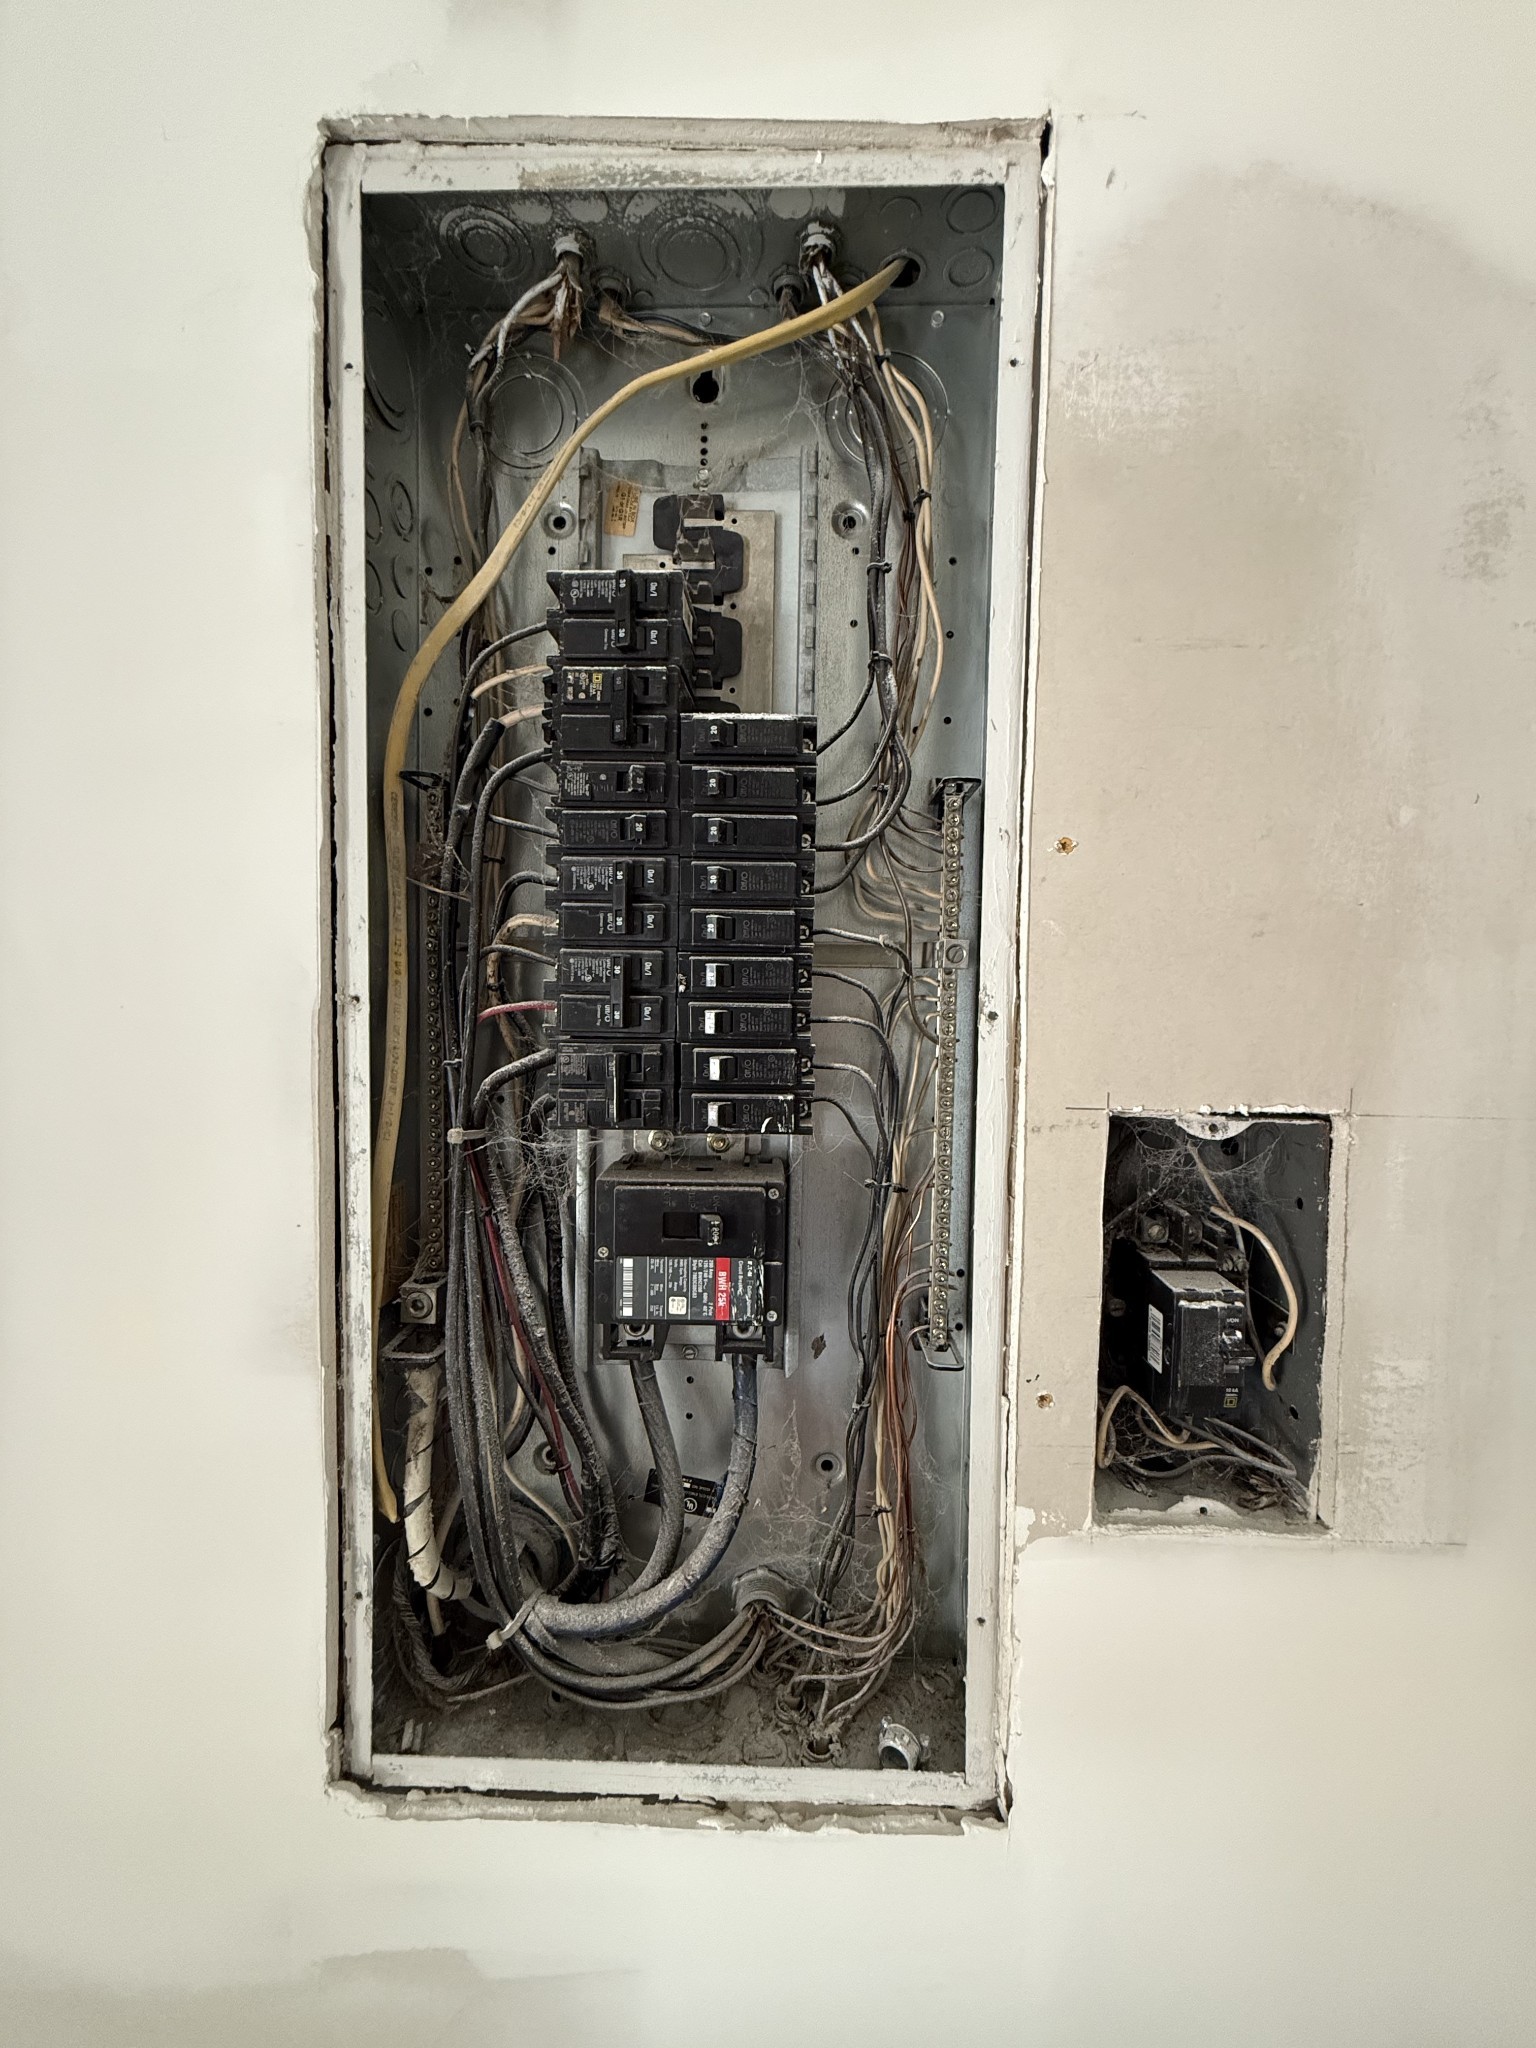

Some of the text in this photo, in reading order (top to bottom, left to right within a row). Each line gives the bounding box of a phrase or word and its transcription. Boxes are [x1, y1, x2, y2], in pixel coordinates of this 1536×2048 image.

[620, 579, 626, 588] 30
[619, 628, 625, 637] 30
[710, 725, 717, 734] 20
[710, 779, 716, 787] 20
[636, 822, 643, 832] 20
[711, 826, 717, 835] 20
[617, 871, 623, 879] 30
[710, 875, 717, 884] 30
[616, 917, 622, 926] 30
[708, 924, 714, 932] 20
[614, 965, 620, 974] 30
[614, 1011, 620, 1019] 30
[718, 1271, 726, 1307] BWH 25k
